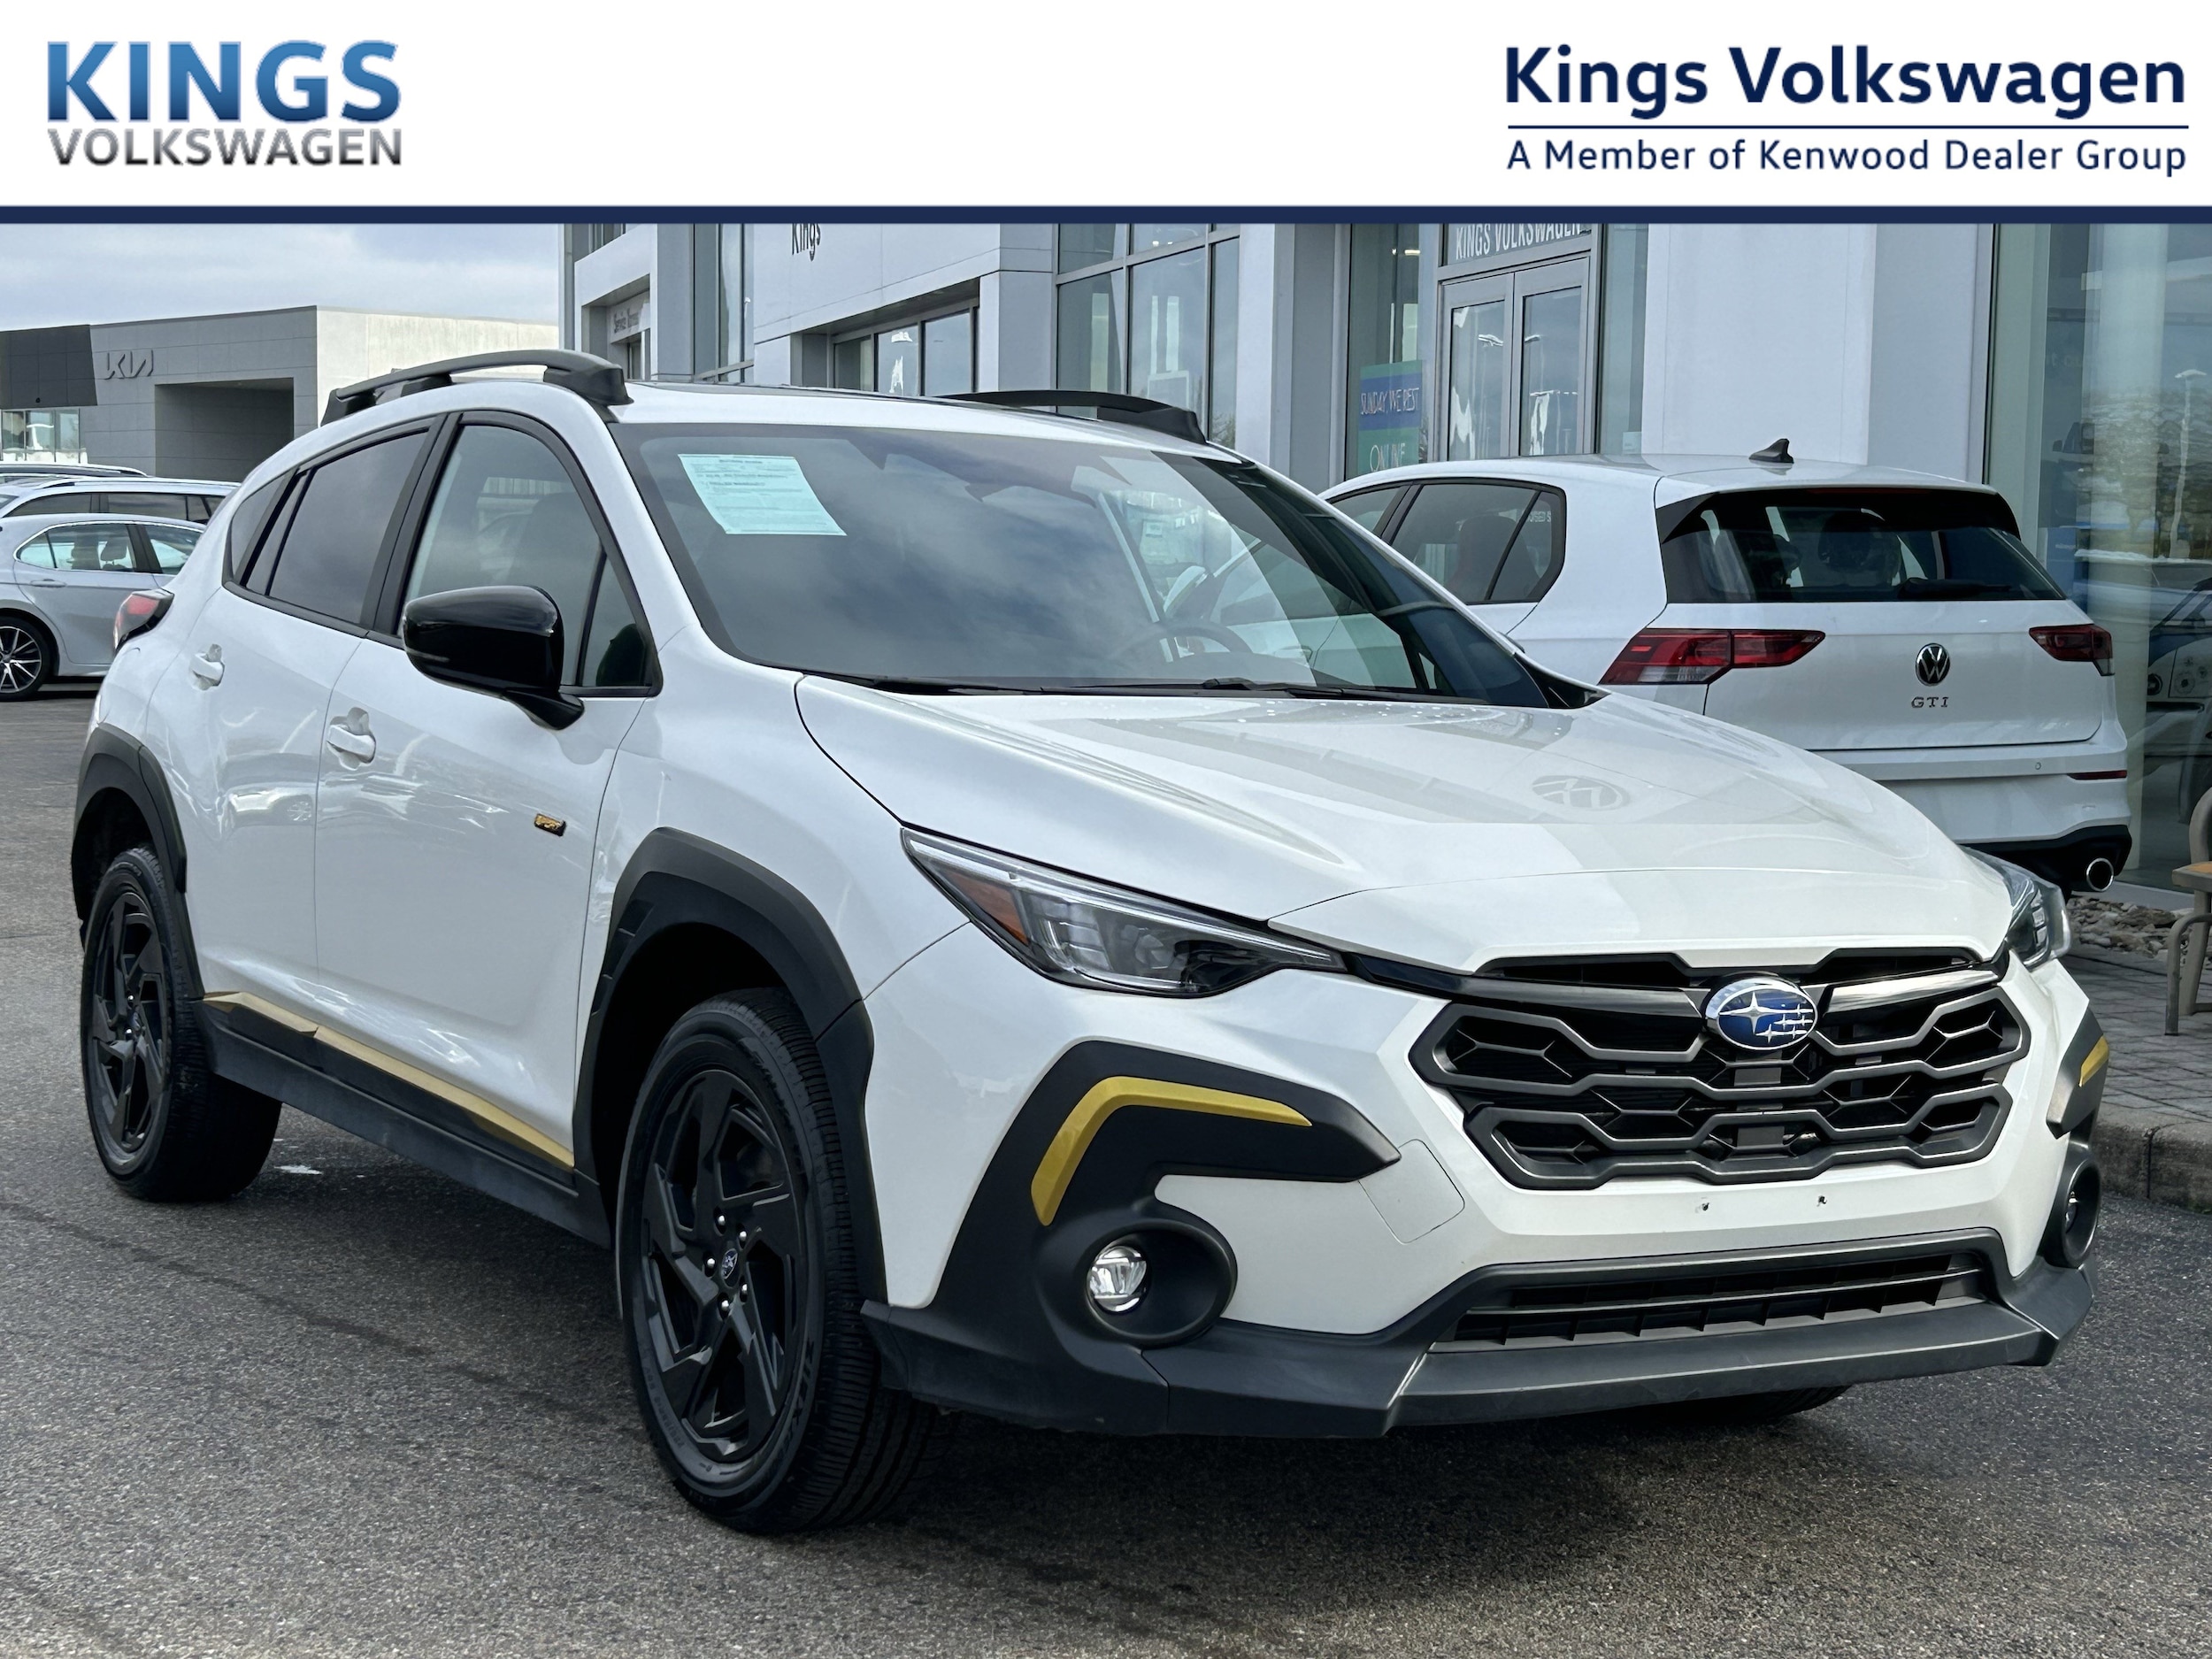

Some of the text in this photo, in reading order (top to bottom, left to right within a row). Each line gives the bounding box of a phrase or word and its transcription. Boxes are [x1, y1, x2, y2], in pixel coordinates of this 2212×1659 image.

[791, 223, 821, 262] Kings
[1455, 223, 1491, 260] KINGS
[1911, 696, 1949, 708] GTI
